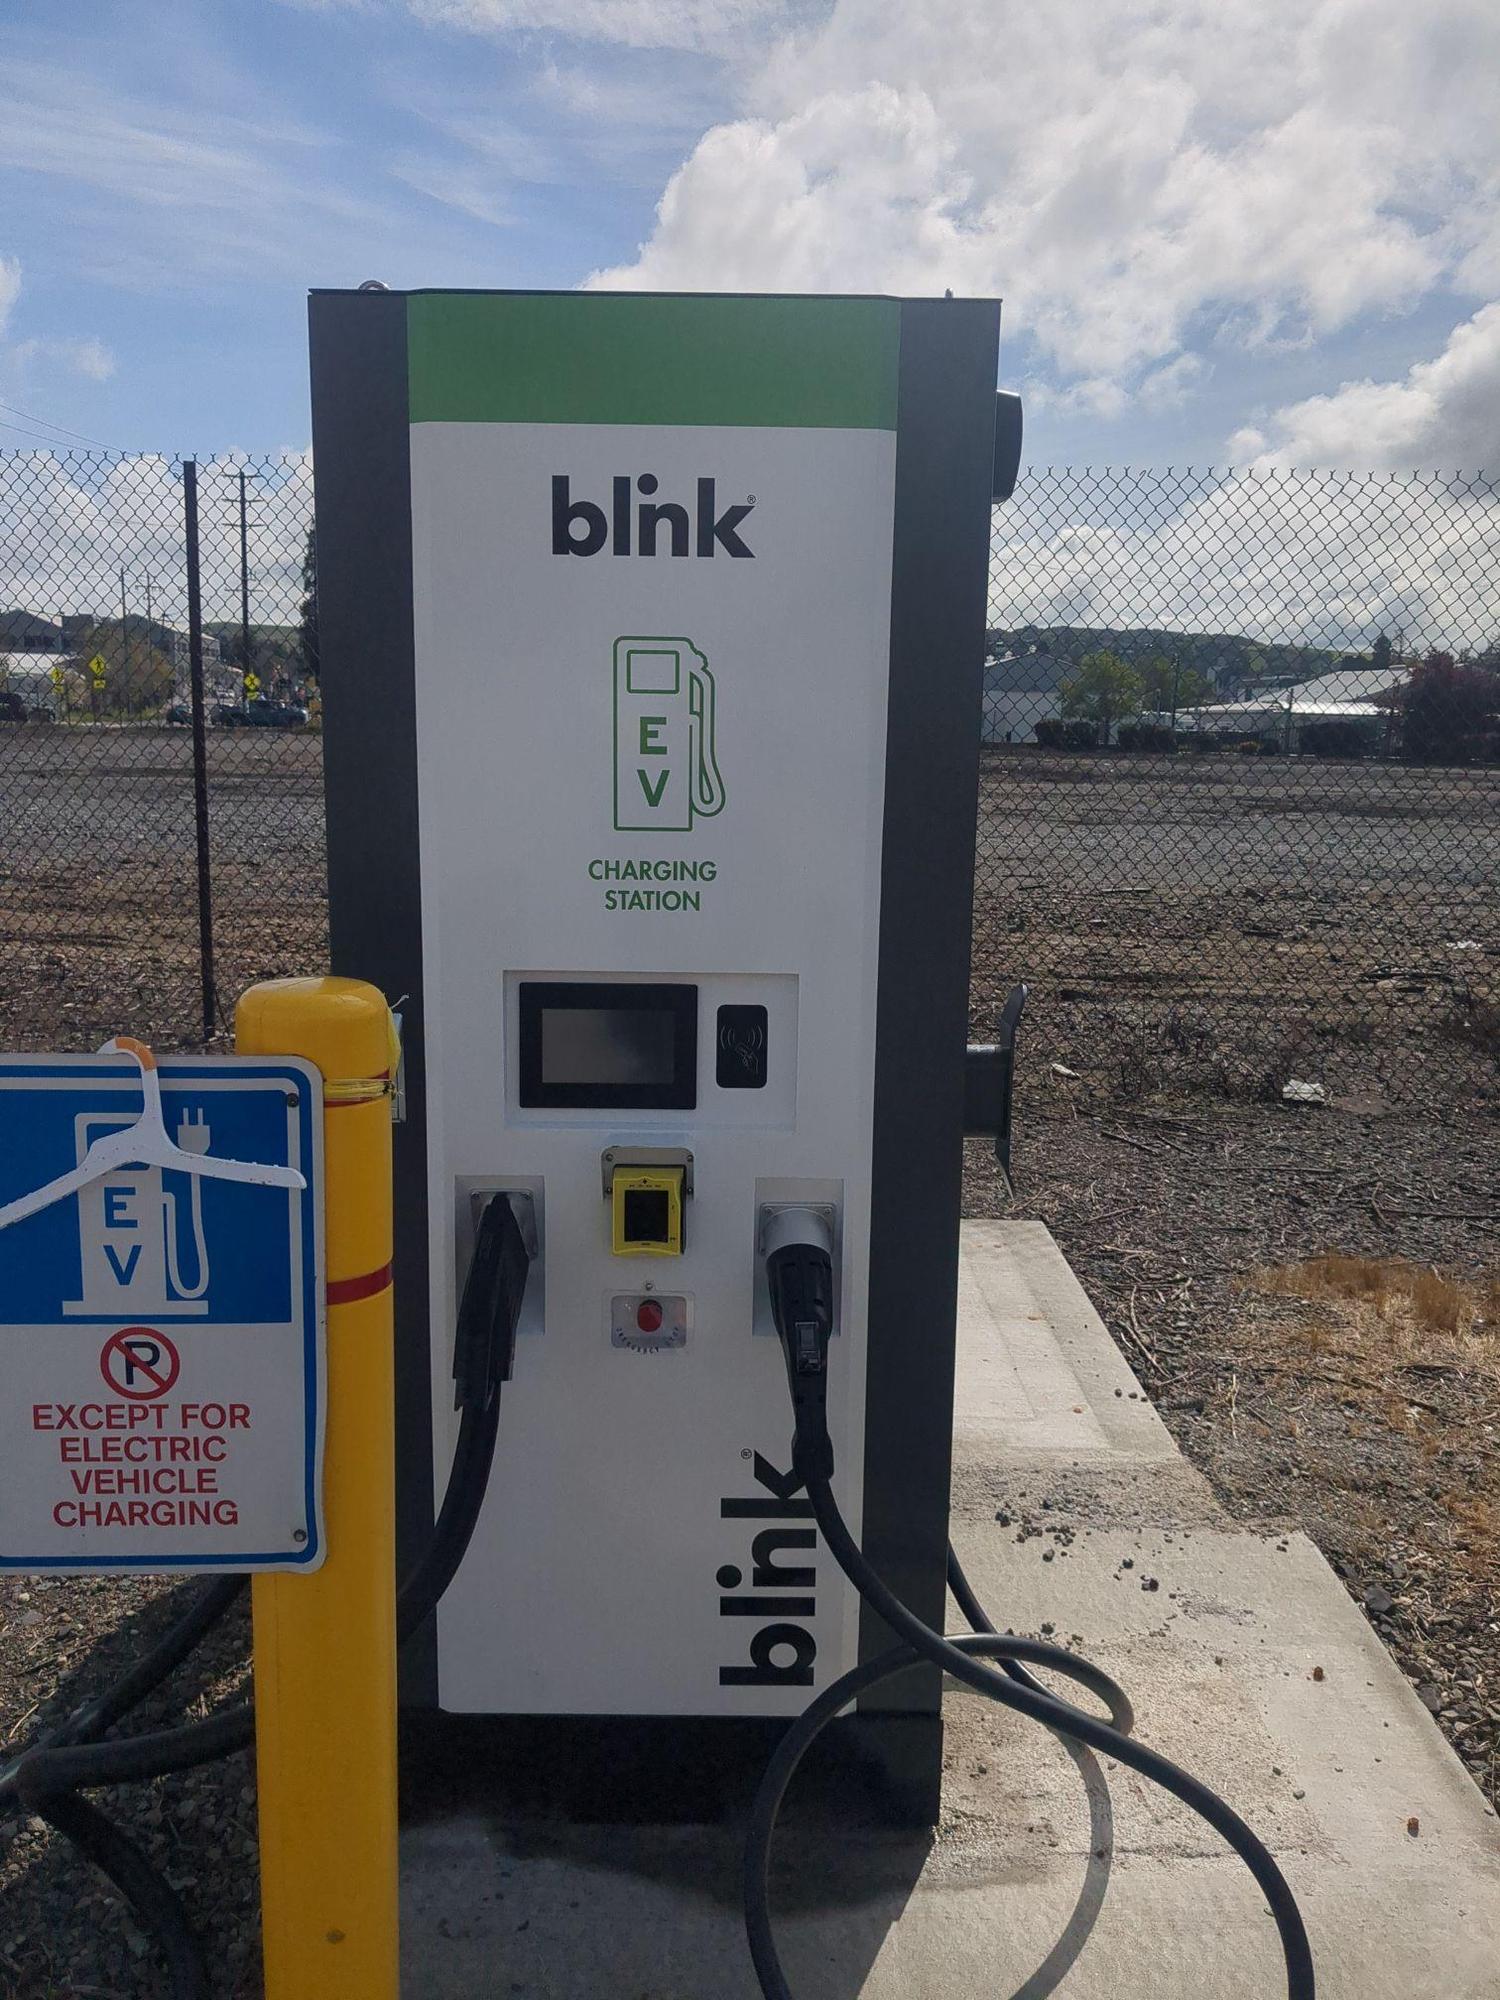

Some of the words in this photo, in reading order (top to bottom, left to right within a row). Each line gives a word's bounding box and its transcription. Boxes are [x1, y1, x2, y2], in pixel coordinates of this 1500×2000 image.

[552, 473, 756, 558] blink
[588, 860, 717, 881] CHARGING
[604, 890, 700, 911] STATION
[32, 1405, 170, 1430] EXCEPT
[181, 1404, 251, 1428] FOR
[60, 1437, 227, 1462] ELECTRIC
[70, 1469, 219, 1495] VEHICLE
[53, 1500, 239, 1527] CHARGING
[716, 1450, 816, 1686] blink
